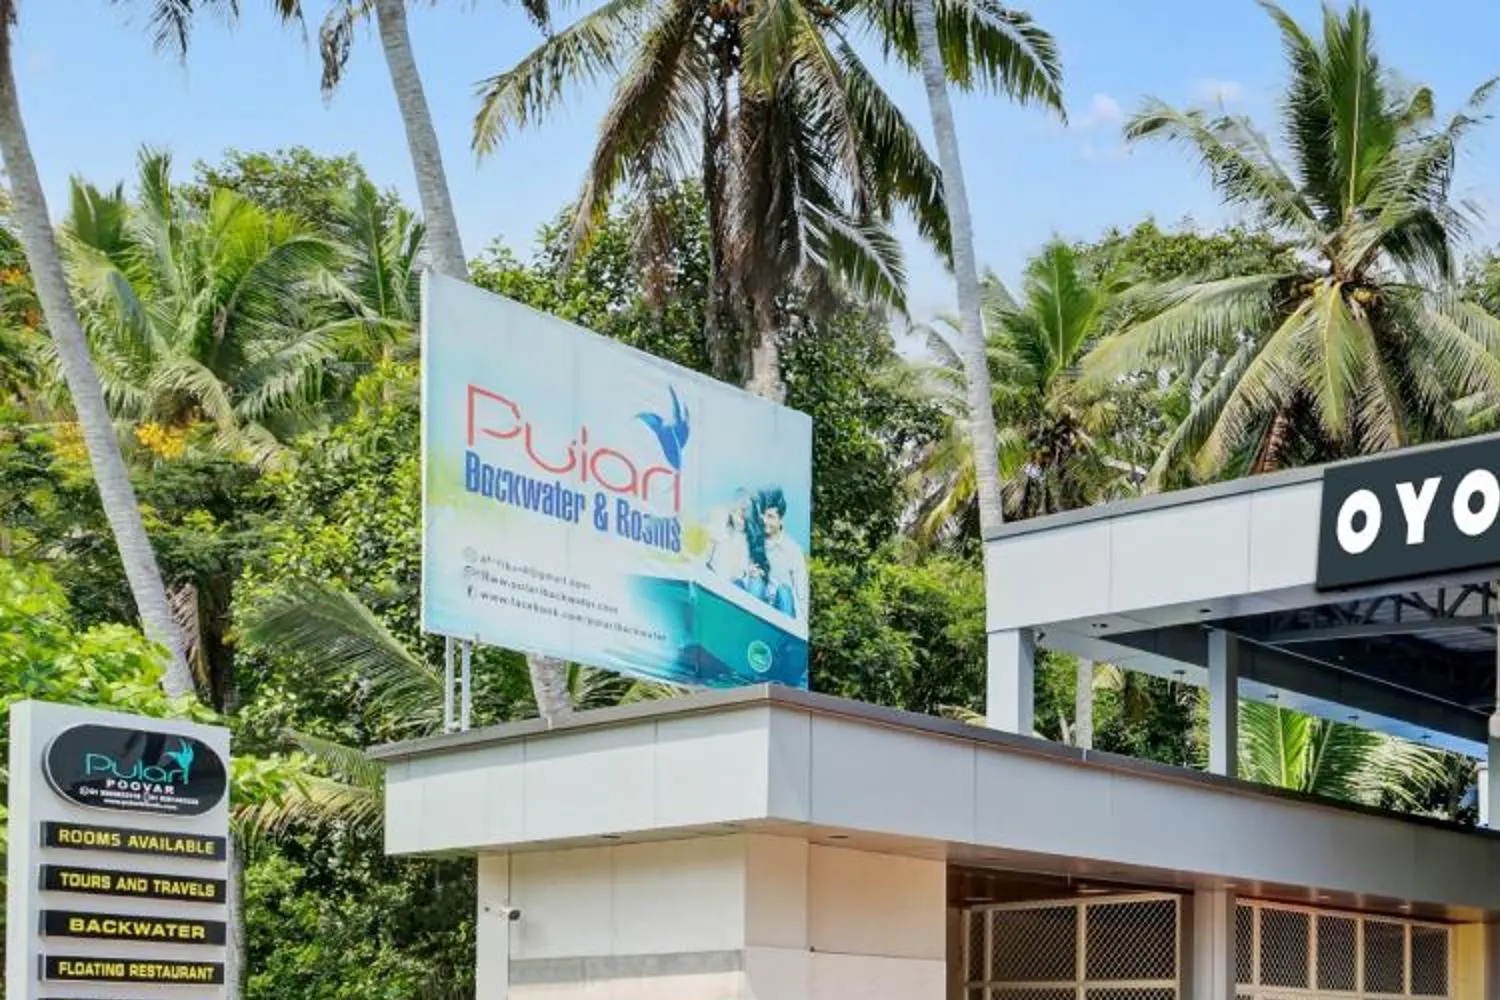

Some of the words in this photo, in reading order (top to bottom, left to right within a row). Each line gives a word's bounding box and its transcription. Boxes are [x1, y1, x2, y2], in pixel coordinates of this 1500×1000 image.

[465, 449, 586, 525] Backwater
[593, 491, 609, 532] &
[616, 498, 682, 553] Rooms
[1337, 469, 1500, 554] OYO
[59, 829, 121, 846] ROOMS
[128, 836, 215, 855] AVAILABLE
[60, 872, 111, 890] TOURS
[116, 876, 147, 891] AND
[153, 880, 215, 897] TRAVELS
[69, 918, 205, 939] BACKWATER
[59, 961, 124, 977] FLOATING
[129, 964, 215, 980] RESTAURANT
